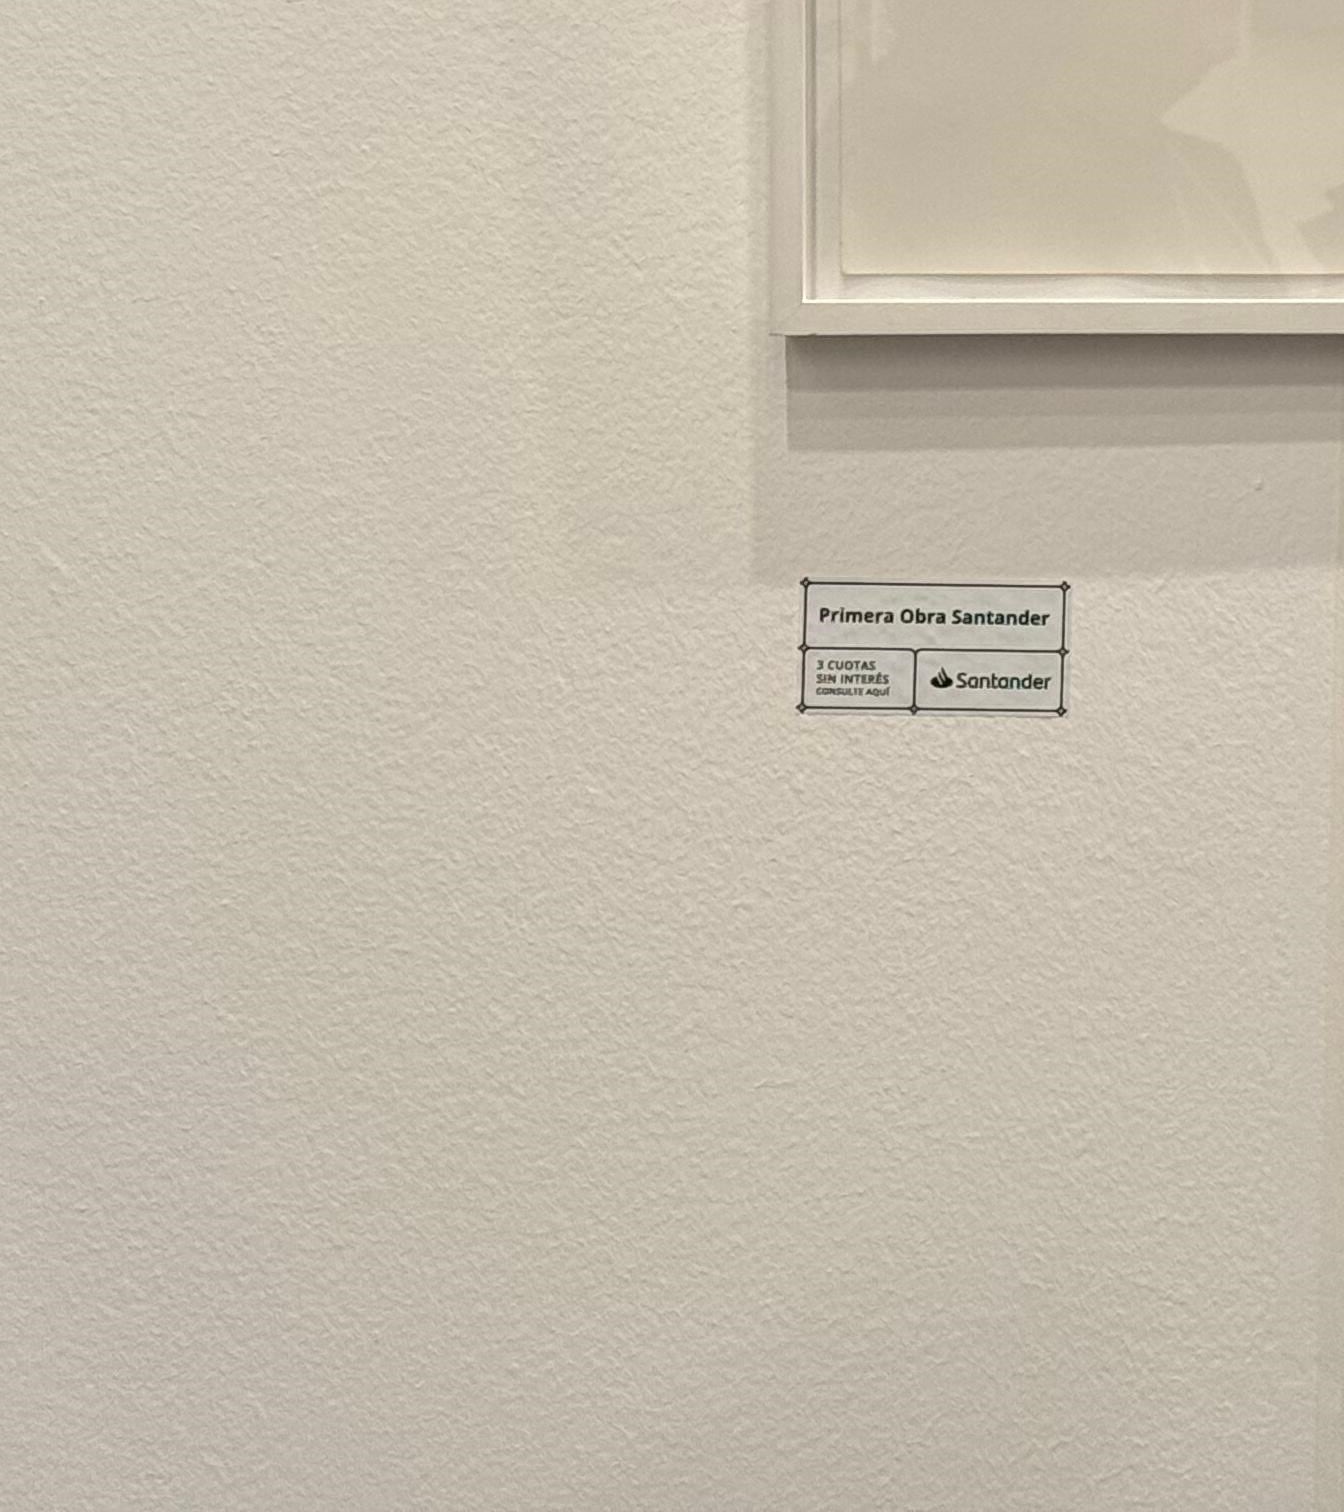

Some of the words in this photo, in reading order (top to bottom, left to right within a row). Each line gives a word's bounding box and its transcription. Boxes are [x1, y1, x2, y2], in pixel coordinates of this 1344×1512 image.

[819, 607, 895, 624] Primera
[899, 608, 947, 625] Obra
[951, 609, 1050, 626] Santander
[816, 659, 824, 670] 3
[827, 659, 877, 670] CUOTAS
[815, 673, 837, 684] SIN
[840, 671, 890, 685] INTERÉS
[955, 672, 1052, 690] Santander
[815, 686, 865, 696] CONSULTE
